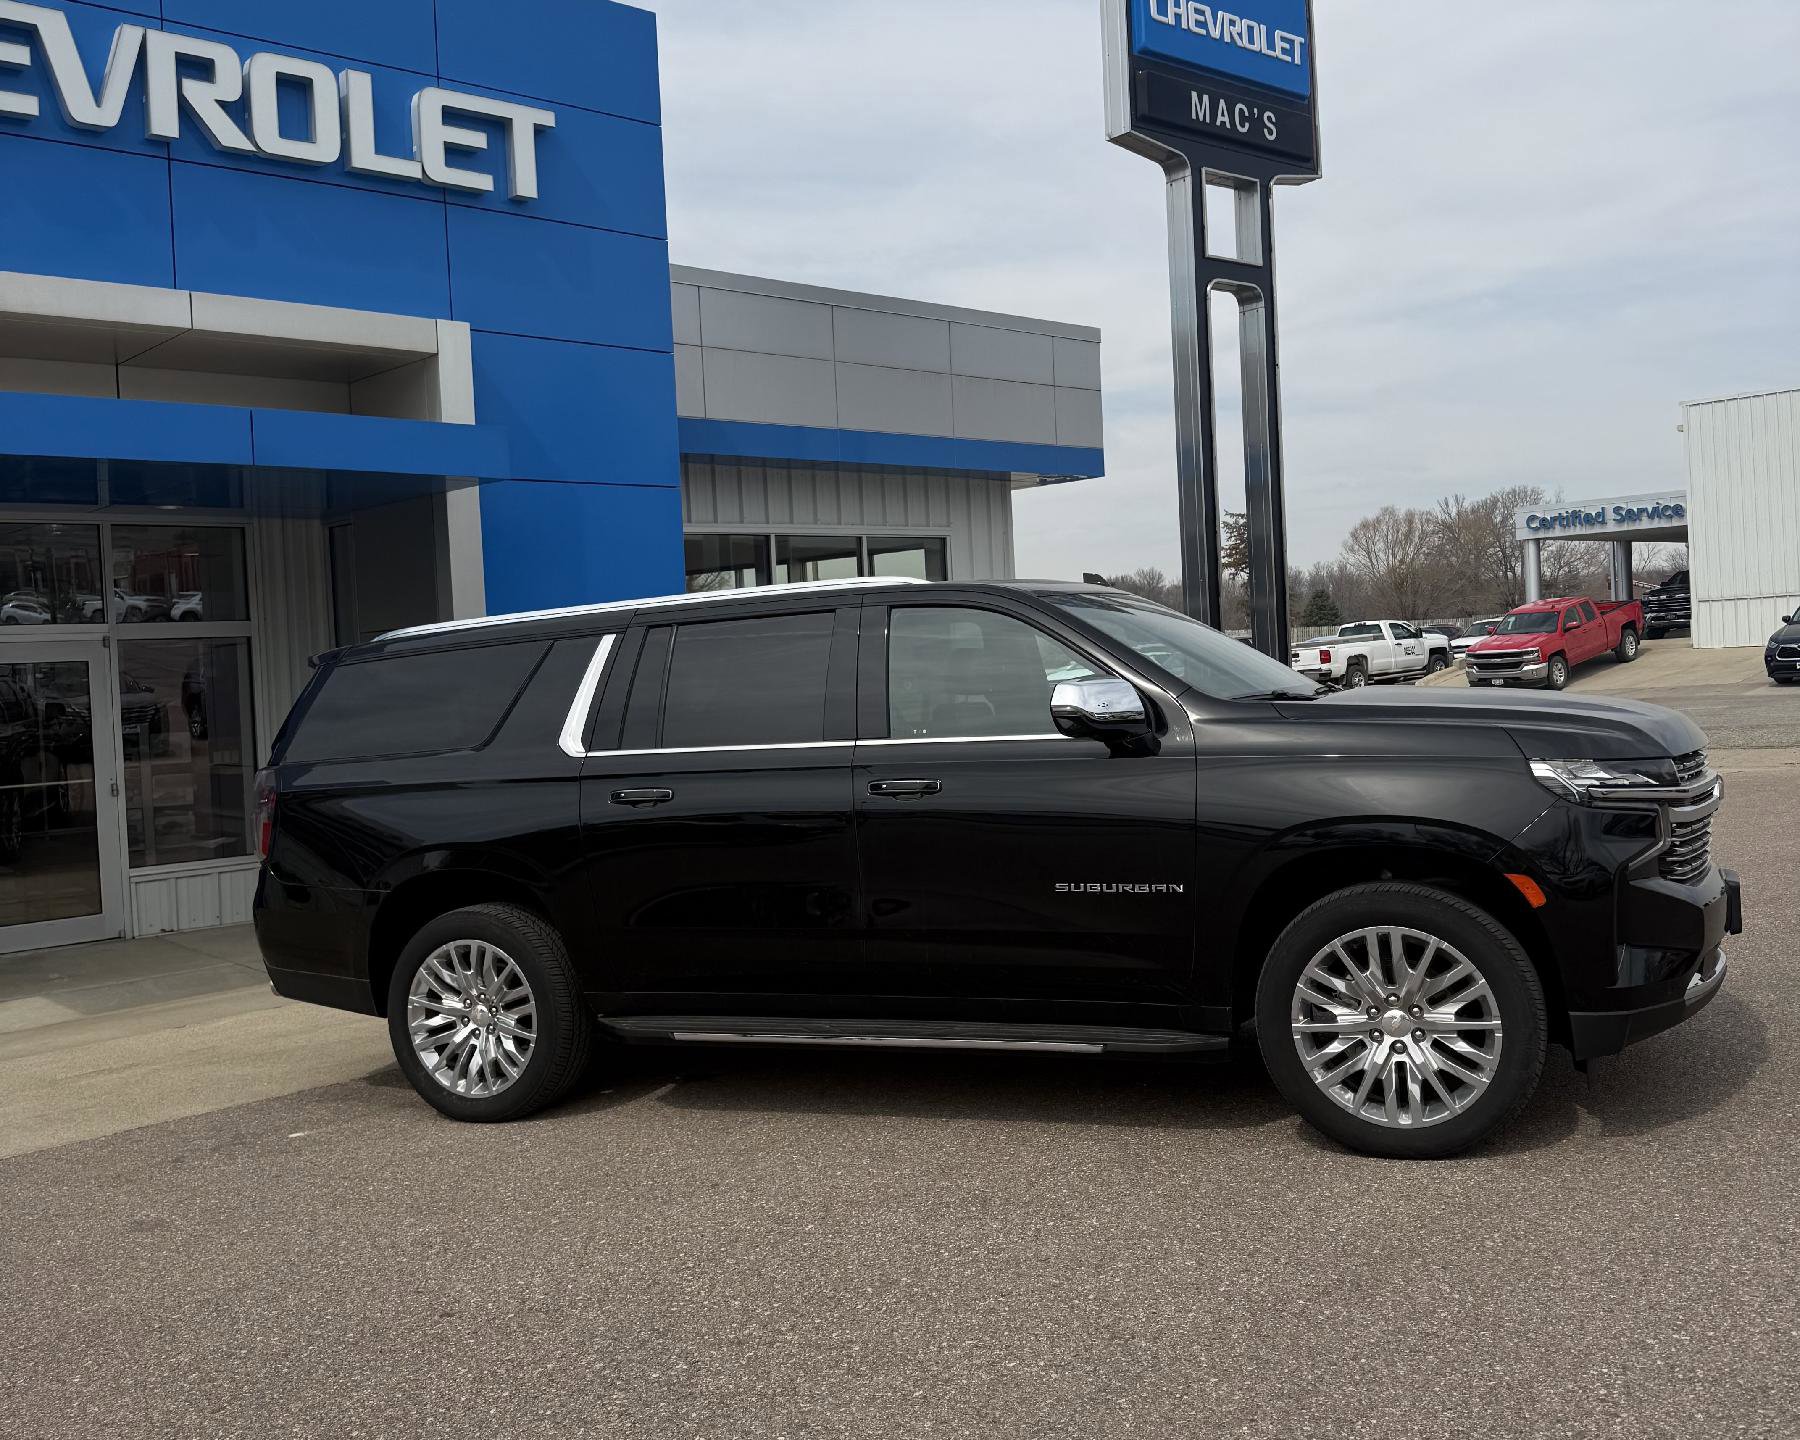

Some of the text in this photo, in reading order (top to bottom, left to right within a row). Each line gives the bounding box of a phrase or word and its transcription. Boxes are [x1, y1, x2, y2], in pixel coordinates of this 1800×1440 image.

[1150, 0, 1304, 65] CHEVROLET
[1191, 91, 1277, 140] MAC'S
[1526, 502, 1685, 530] Certified Service
[1054, 883, 1184, 893] SUBURBAN
